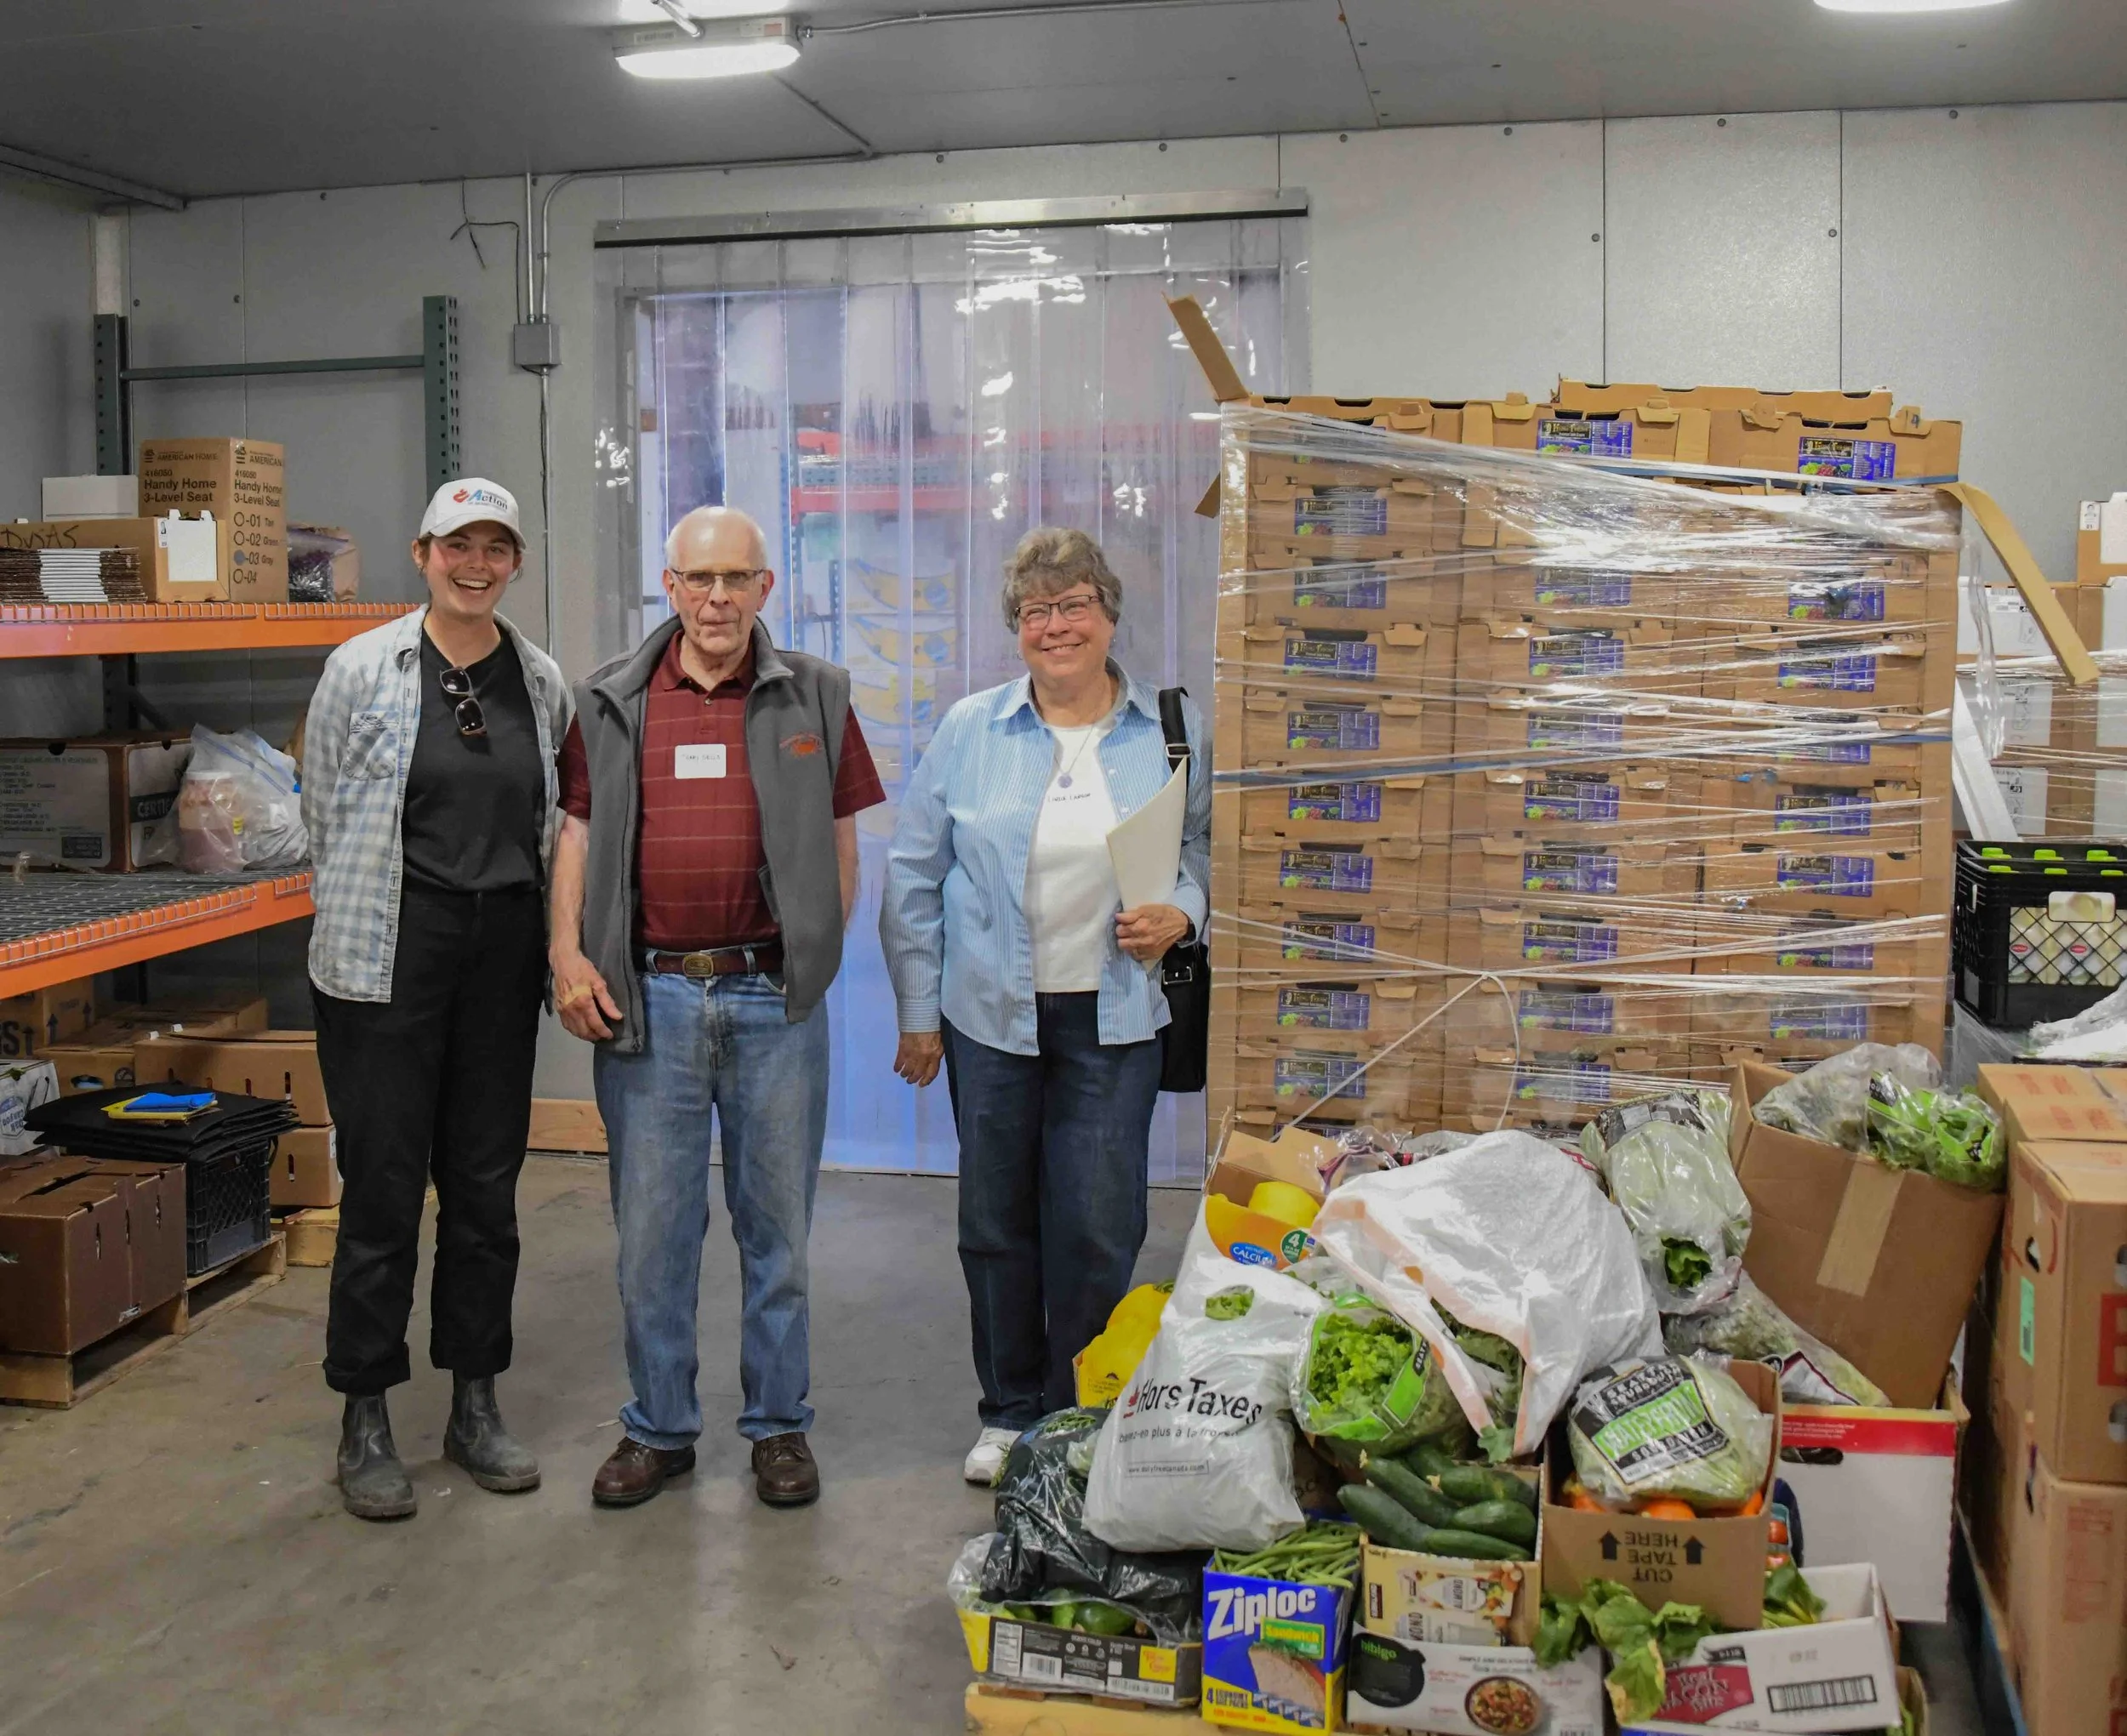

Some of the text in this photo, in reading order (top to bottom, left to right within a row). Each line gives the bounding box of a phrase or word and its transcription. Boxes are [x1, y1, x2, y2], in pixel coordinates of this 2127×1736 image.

[144, 478, 217, 491] Handy Home
[234, 480, 282, 494] Handy Home
[144, 492, 213, 503] 3-Level Seat
[234, 493, 280, 508] 3-Level Seat
[467, 489, 508, 510] Action
[1288, 1233, 1300, 1247] 4
[1233, 1246, 1273, 1265] CALCIUM
[1137, 1378, 1263, 1425] Hors Taxes
[1151, 1426, 1172, 1441] plus
[1625, 1531, 1678, 1547] HERE
[1628, 1549, 1678, 1565] TAPE
[1633, 1567, 1673, 1582] CUT
[1453, 1579, 1463, 1609] ALMOND
[1208, 1586, 1316, 1641] Ziploc
